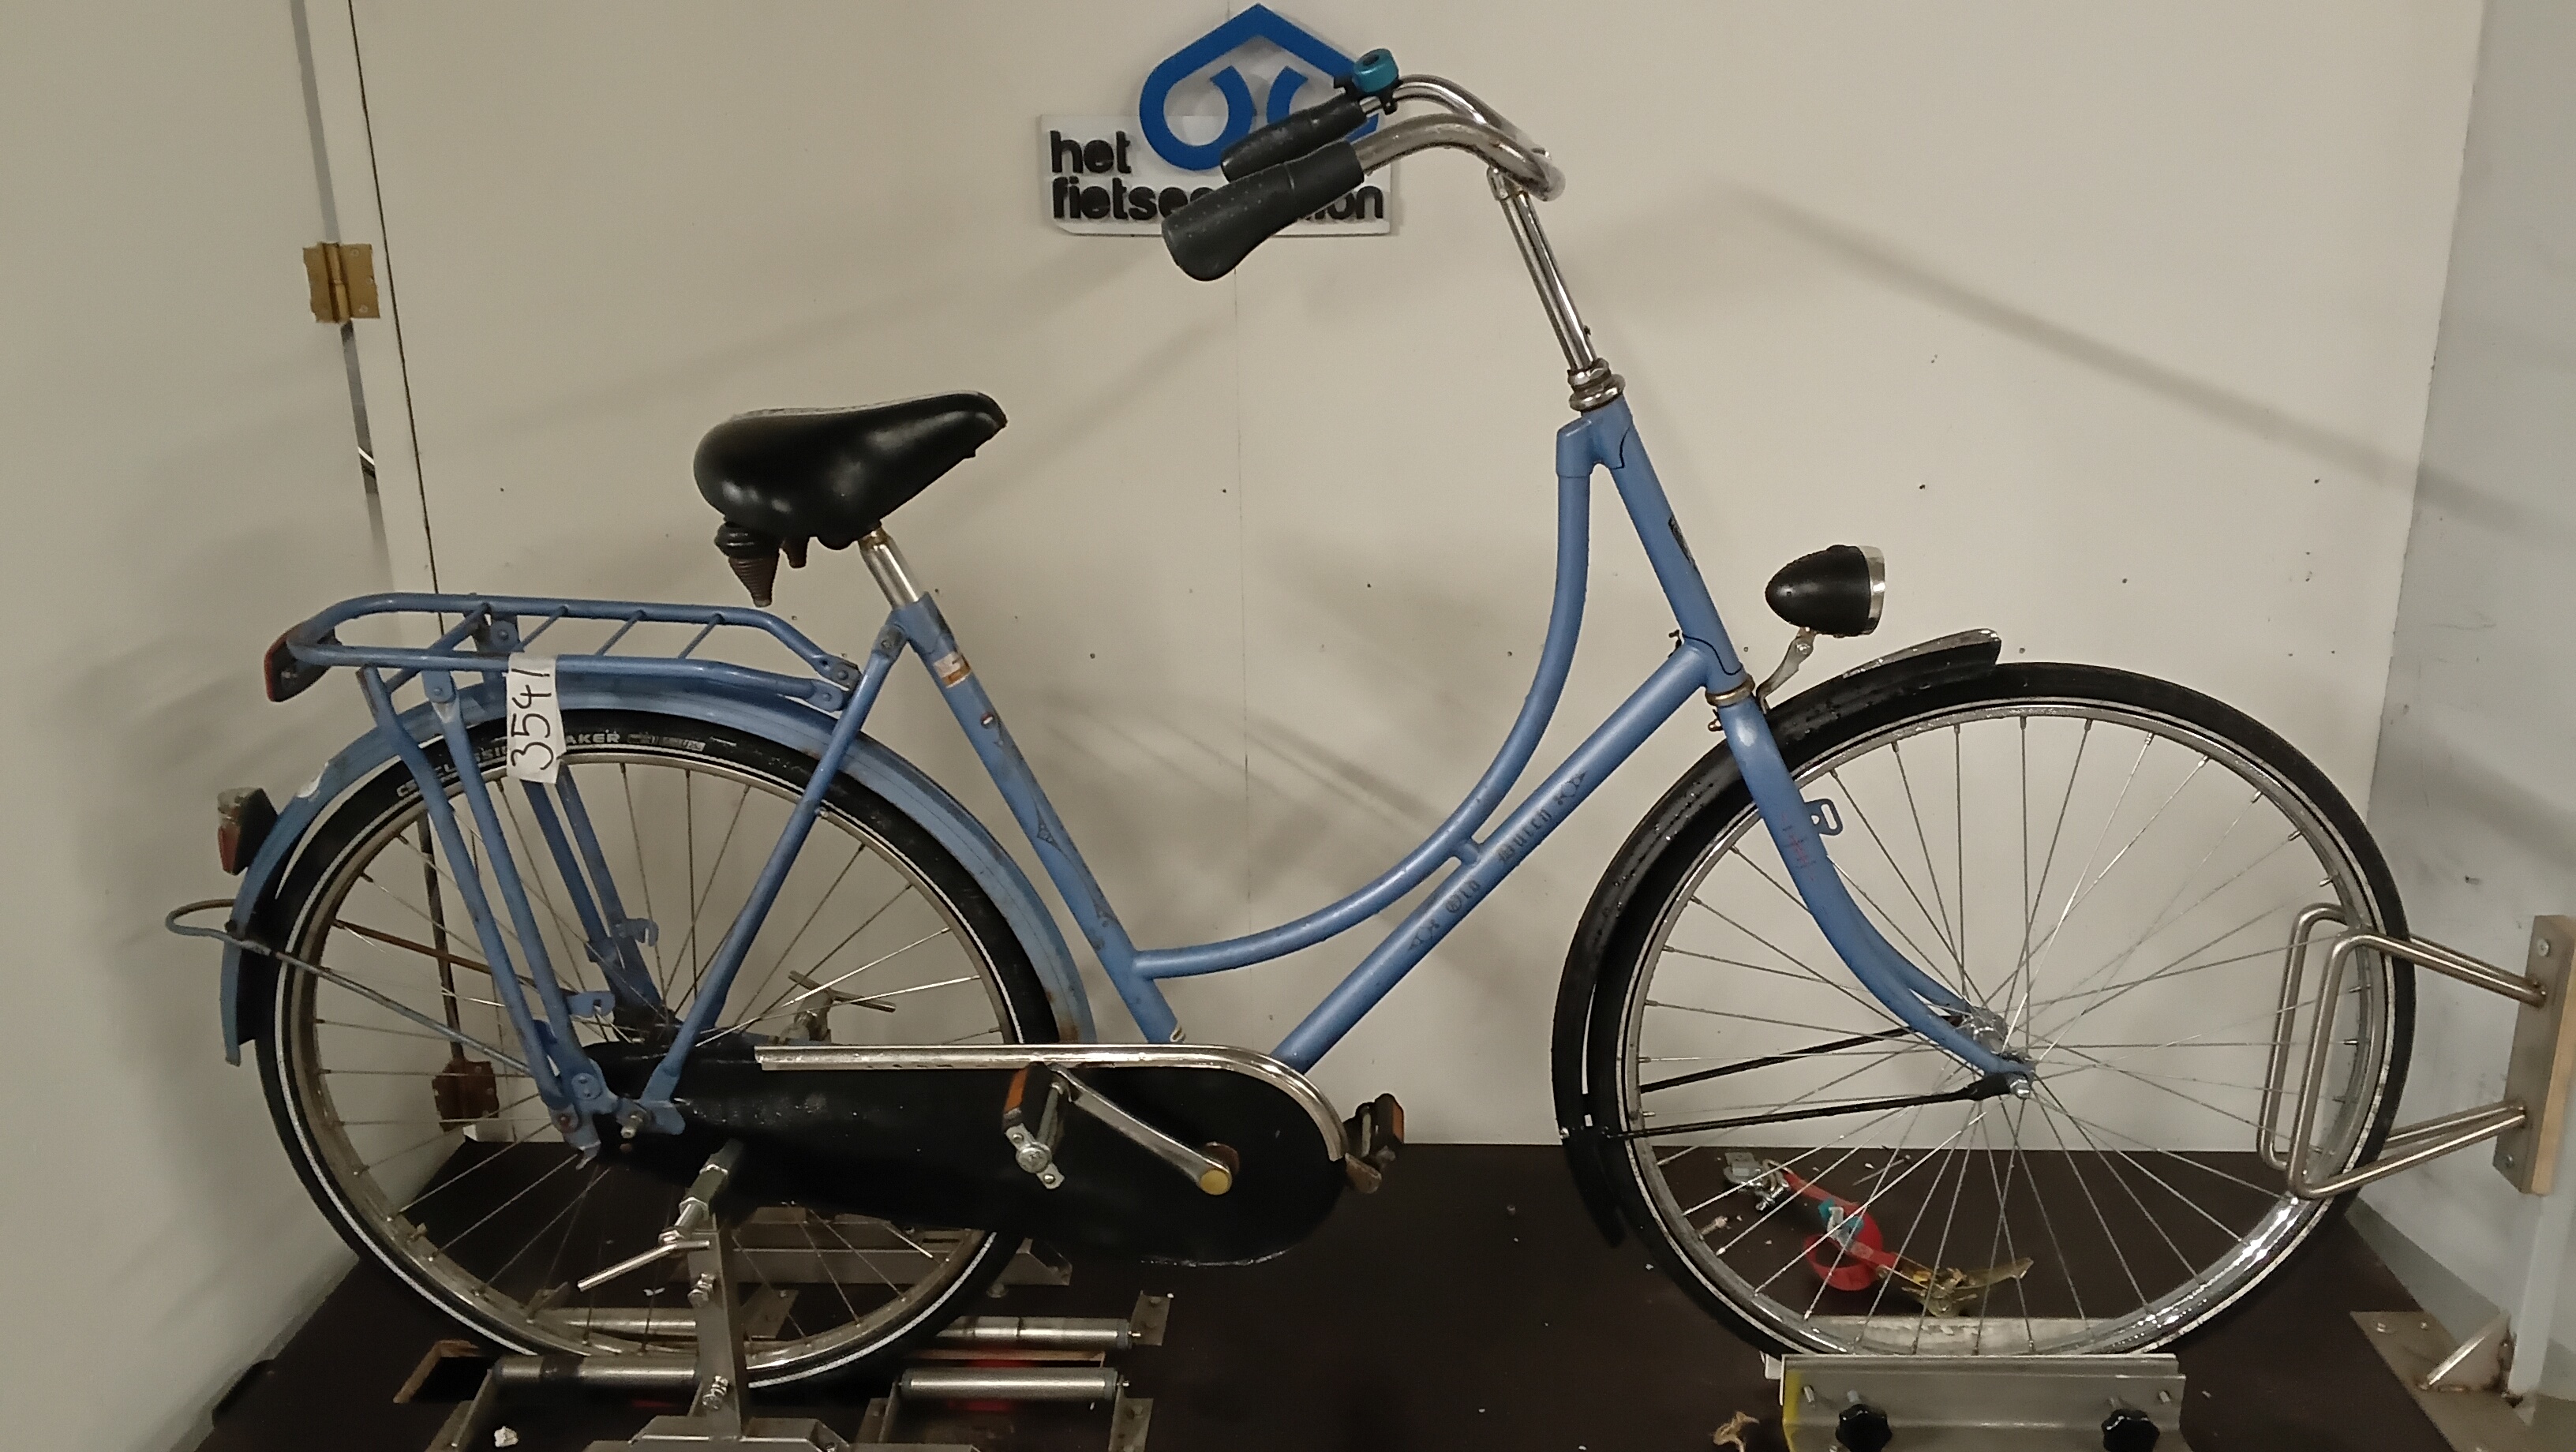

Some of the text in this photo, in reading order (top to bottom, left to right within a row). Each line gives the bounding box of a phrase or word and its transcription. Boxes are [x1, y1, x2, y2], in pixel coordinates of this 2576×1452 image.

[1050, 129, 1132, 174] het
[510, 668, 554, 771] 3541
[565, 732, 621, 744] AKER
